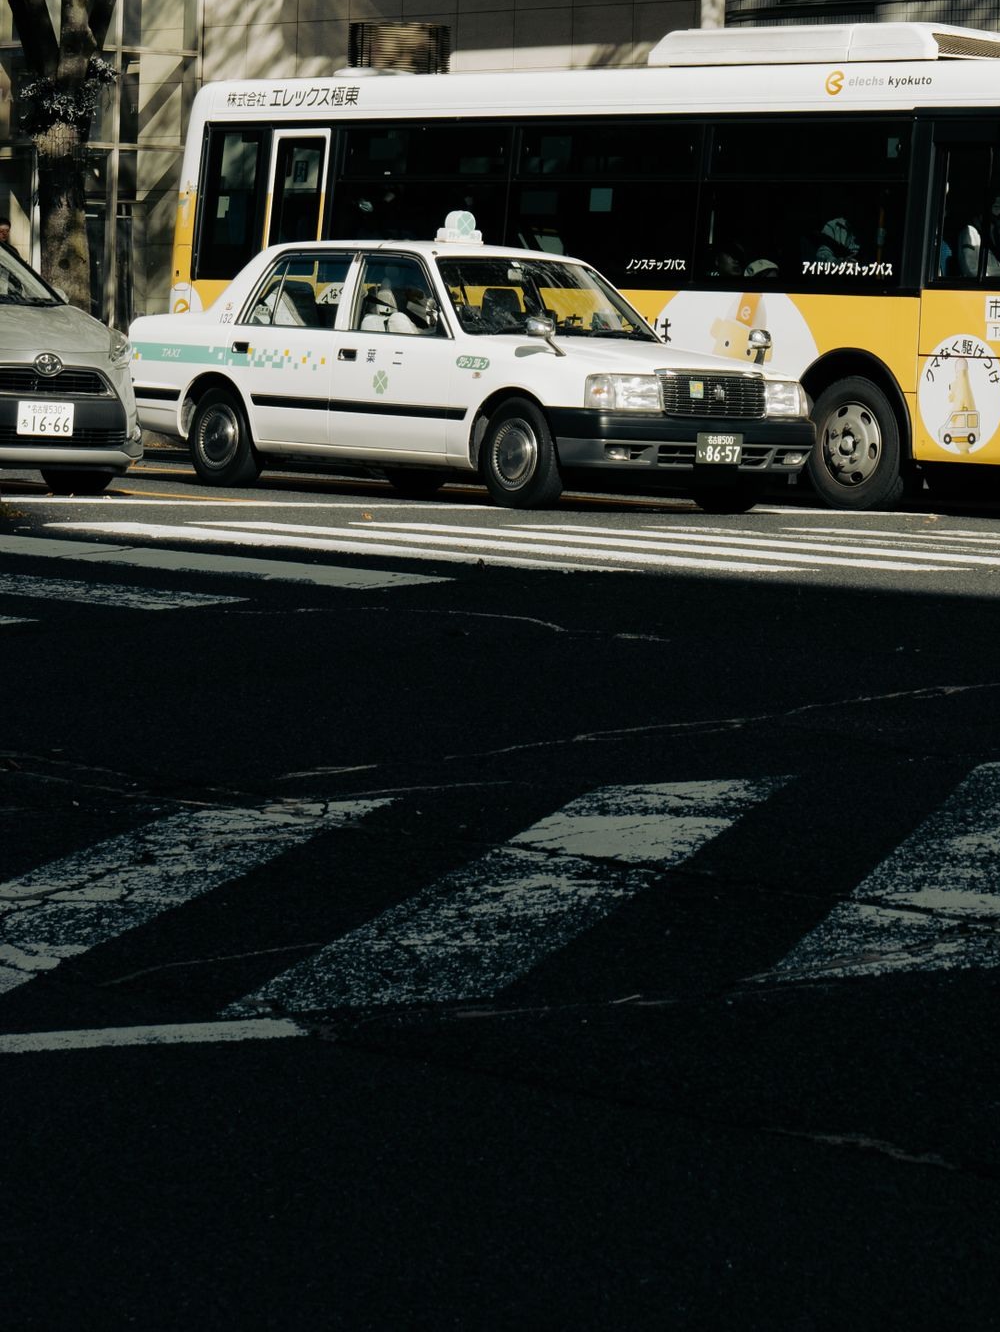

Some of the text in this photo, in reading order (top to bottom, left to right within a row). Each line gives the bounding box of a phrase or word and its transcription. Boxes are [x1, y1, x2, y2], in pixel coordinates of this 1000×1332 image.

[848, 75, 932, 88] elechs kyokuto
[227, 86, 361, 107] 株式会社 エレックス極東
[626, 258, 686, 271] ノンステップバス
[801, 260, 893, 277] アイドリングストップバス
[219, 313, 234, 324] 132
[161, 347, 182, 358] TAXI
[926, 339, 1000, 384] クマなく駆けつけ
[31, 415, 71, 433] 16-66
[706, 445, 741, 463] 86-57
